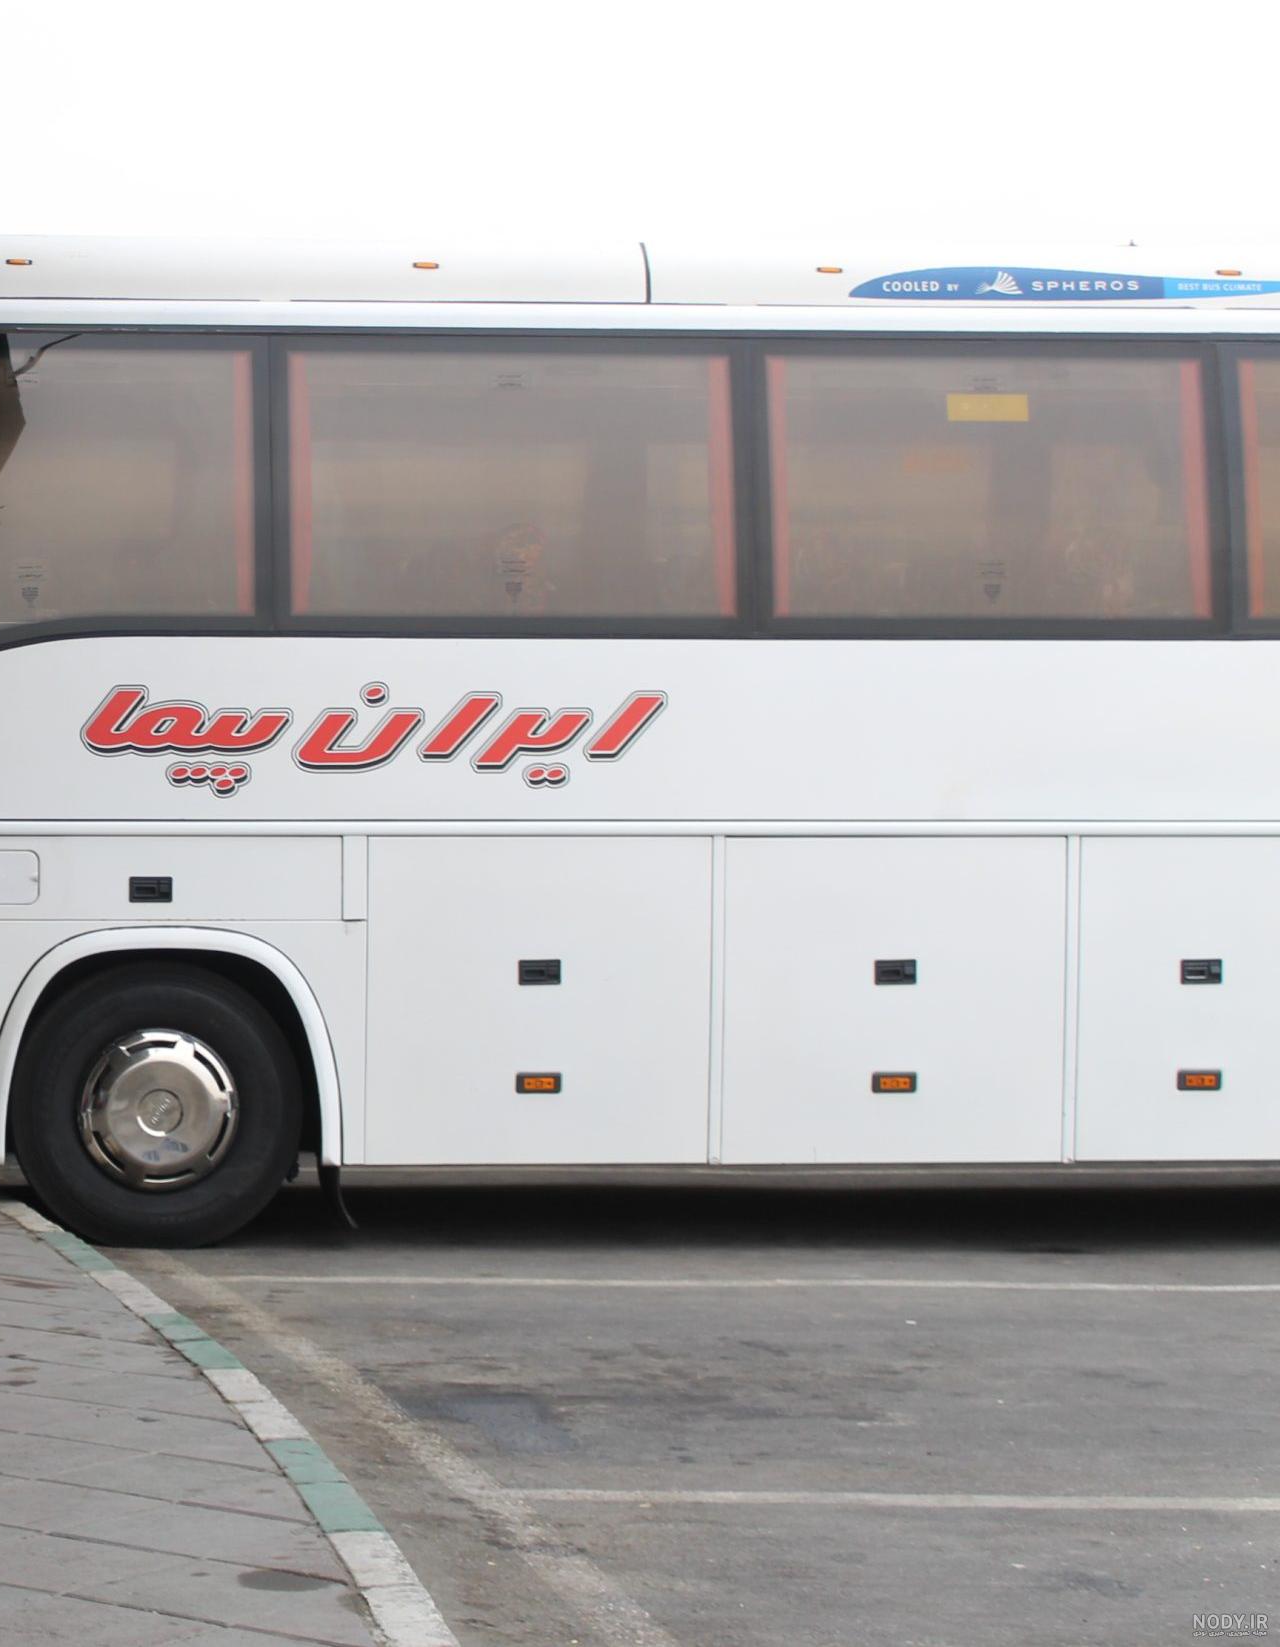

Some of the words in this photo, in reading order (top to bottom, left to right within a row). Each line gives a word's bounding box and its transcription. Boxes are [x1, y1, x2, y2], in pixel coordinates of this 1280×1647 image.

[882, 280, 939, 292] COOLED
[946, 284, 959, 292] BY
[1031, 280, 1140, 291] SPHEROS
[80, 684, 293, 798] پیما
[290, 681, 668, 789] ایران
